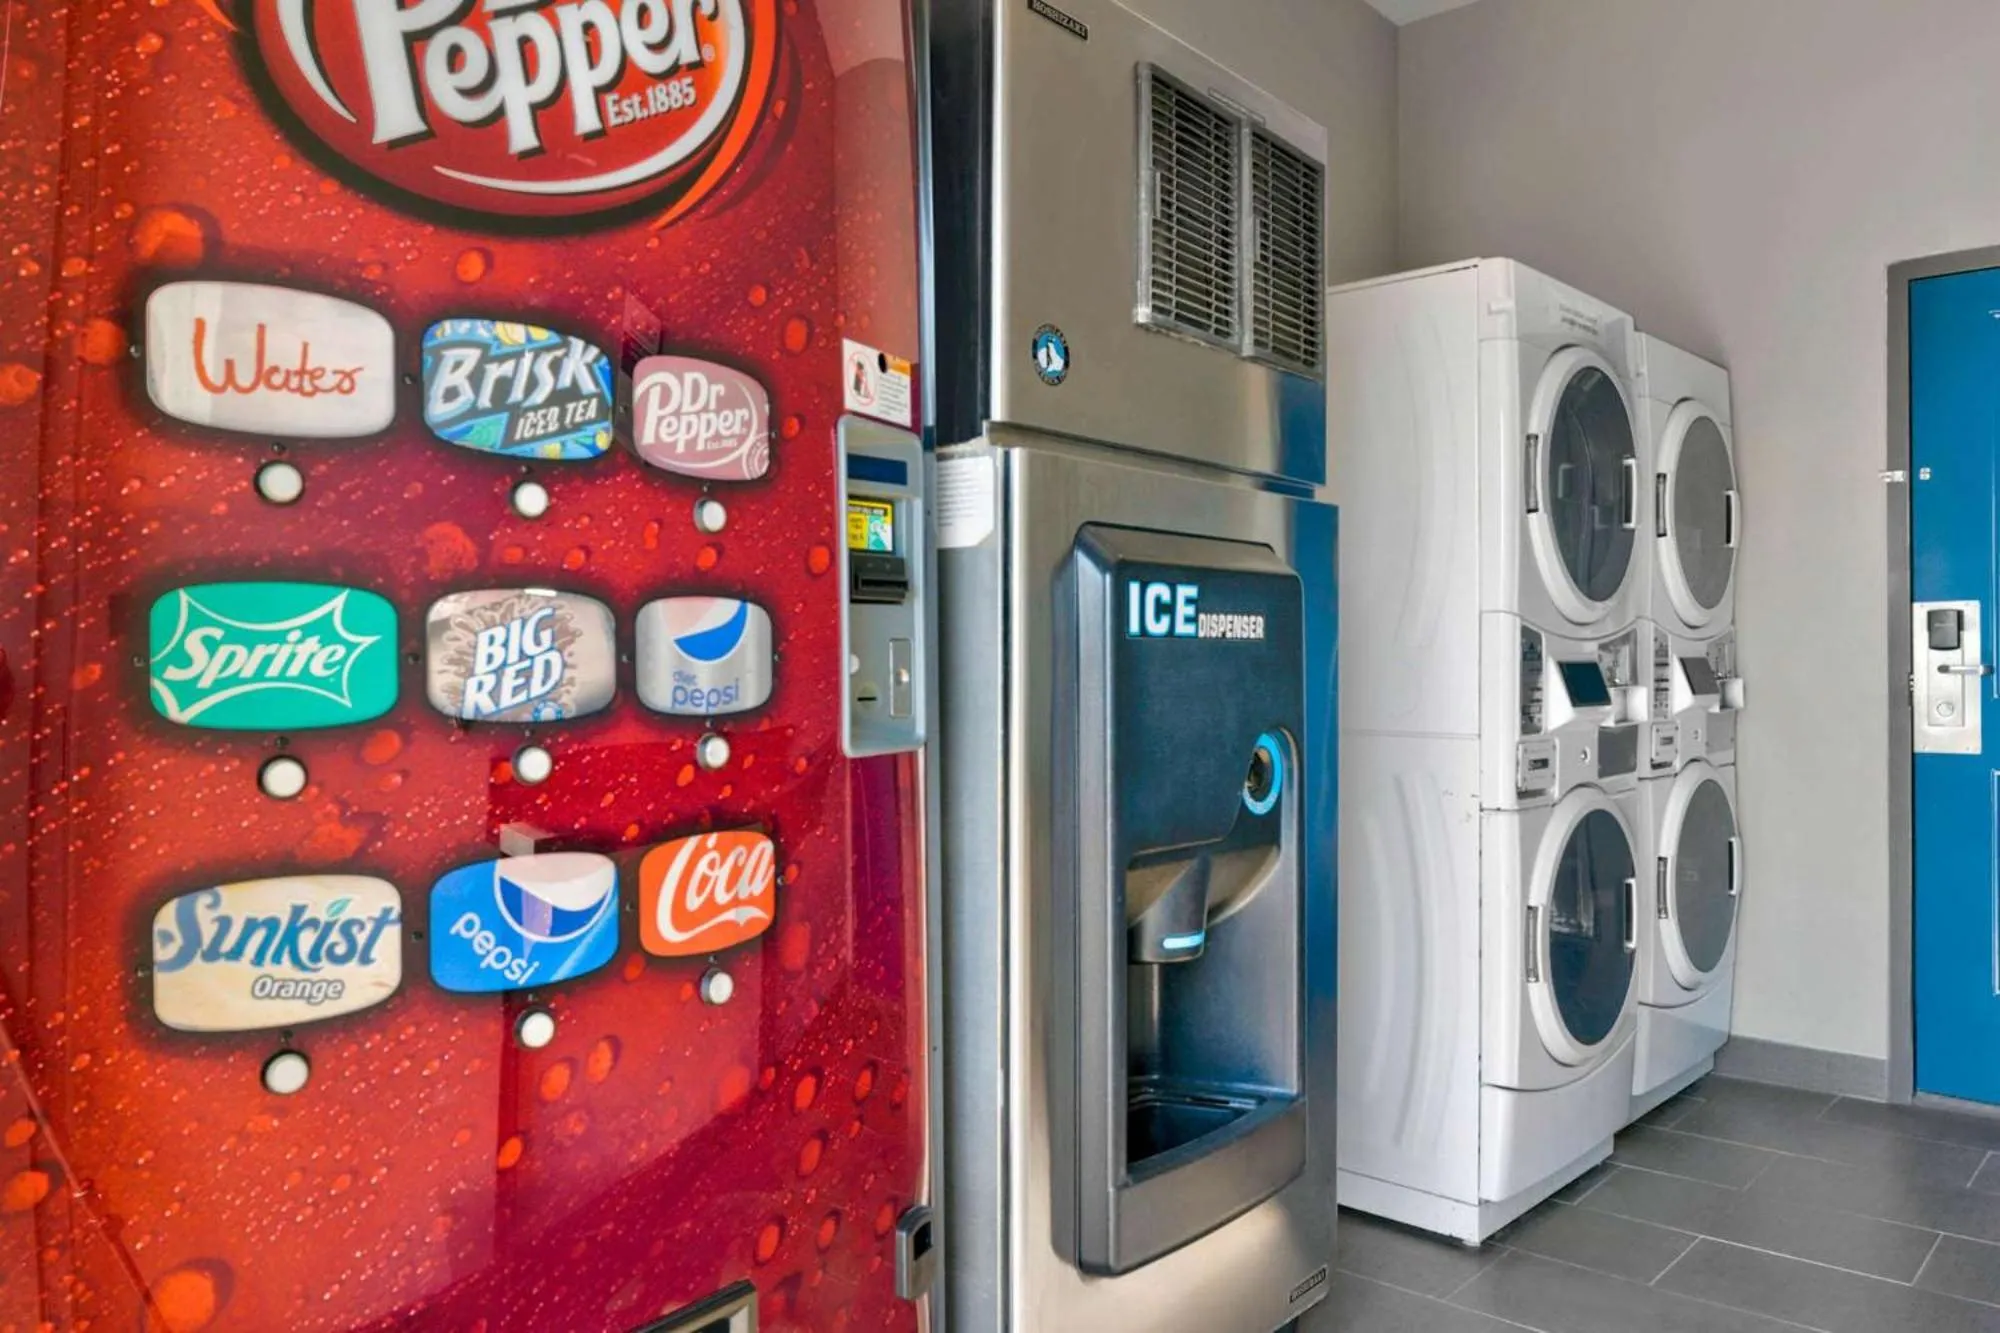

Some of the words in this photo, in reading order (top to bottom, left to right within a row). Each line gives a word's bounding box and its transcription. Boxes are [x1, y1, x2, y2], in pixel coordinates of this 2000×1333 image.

[193, 317, 364, 397] Water
[681, 371, 725, 413] Dr
[514, 406, 560, 441] ICED
[565, 398, 598, 428] TEA
[634, 371, 749, 454] Pepper
[475, 608, 555, 675] BIG
[1128, 580, 1199, 637] ICE
[1198, 613, 1265, 639] DISPENSER
[162, 616, 347, 688] Sprite
[462, 650, 564, 720] RED
[671, 677, 740, 714] pepsi
[656, 832, 776, 943] Coca
[155, 887, 402, 973] Sunkist
[449, 911, 540, 986] pepsi
[253, 975, 345, 1005] Orange
